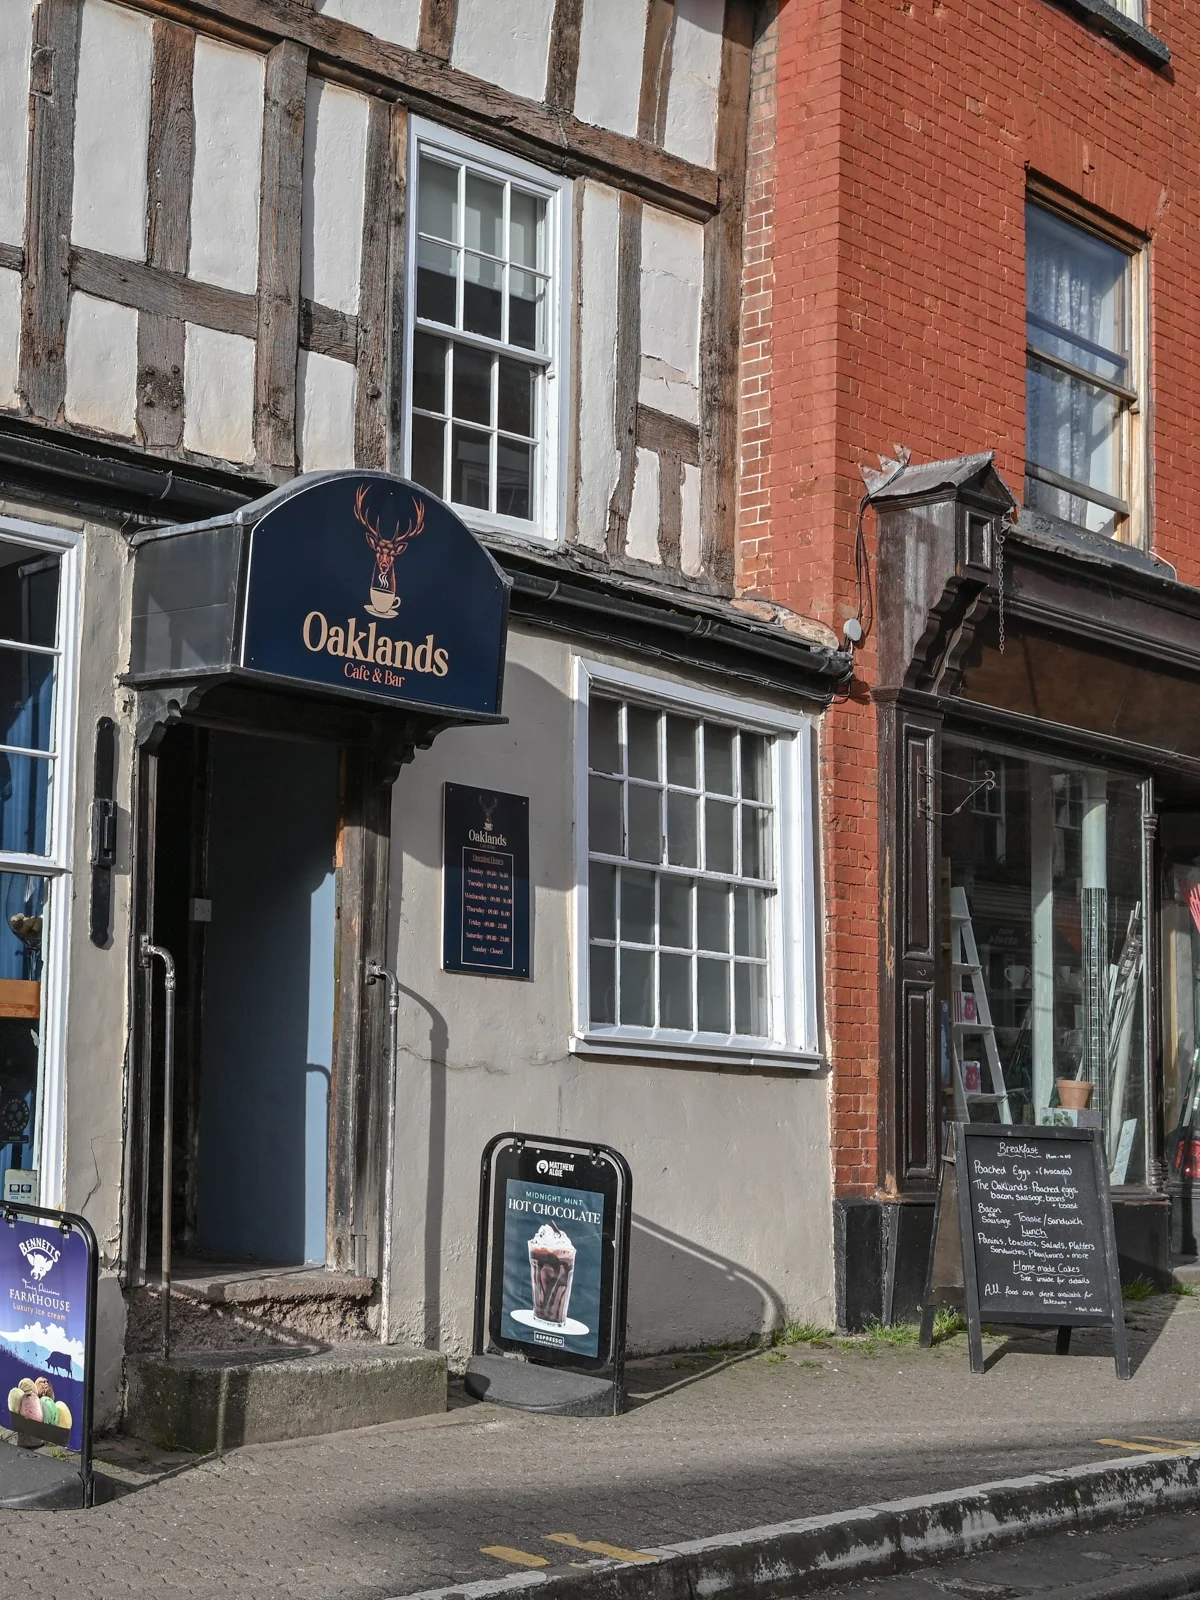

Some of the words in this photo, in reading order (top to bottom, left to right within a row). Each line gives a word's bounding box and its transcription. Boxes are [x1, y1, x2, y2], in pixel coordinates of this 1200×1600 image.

[303, 610, 449, 677] Oaklands
[344, 662, 370, 681] Cafe
[373, 669, 382, 684] &
[385, 670, 405, 688] Bar
[468, 830, 507, 846] Oaklands
[468, 867, 484, 876] Monday
[468, 880, 484, 889] Tuesday
[465, 892, 487, 902] Wednesday
[466, 906, 485, 915] Thursday
[468, 919, 481, 927] Friday
[466, 932, 483, 941] Saturday
[472, 946, 487, 954] Sunday
[999, 1142, 1038, 1157] Breakfast
[548, 1169, 563, 1177] ALGIE
[549, 1161, 575, 1172] MATTHEW
[973, 1160, 1006, 1175] Poached
[1012, 1165, 1031, 1181] Eggs
[973, 1179, 989, 1190] The
[991, 1180, 1028, 1191] Oaklands
[1031, 1181, 1060, 1193] Poached
[526, 1191, 562, 1202] MIDNIGHT
[564, 1196, 583, 1206] MINT
[1045, 1194, 1066, 1202] beans
[508, 1198, 531, 1212] HOT
[533, 1204, 601, 1225] CHOCOLATE
[977, 1202, 1002, 1213] Bacon
[981, 1216, 1012, 1229] Sausage
[1021, 1225, 1047, 1237] Lunch
[18, 1237, 61, 1263] BENNETTS
[1013, 1260, 1036, 1272] Home
[1037, 1265, 1056, 1273] made
[1057, 1263, 1080, 1273] Cakes
[984, 1283, 1002, 1296] All
[1004, 1285, 1019, 1297] food
[1084, 1291, 1093, 1300] for
[9, 1288, 70, 1312] FARMHOUSE
[13, 1303, 33, 1314] Luxury
[35, 1307, 45, 1316] ice
[48, 1311, 67, 1321] cream
[536, 1334, 562, 1344] ESPRESSO
